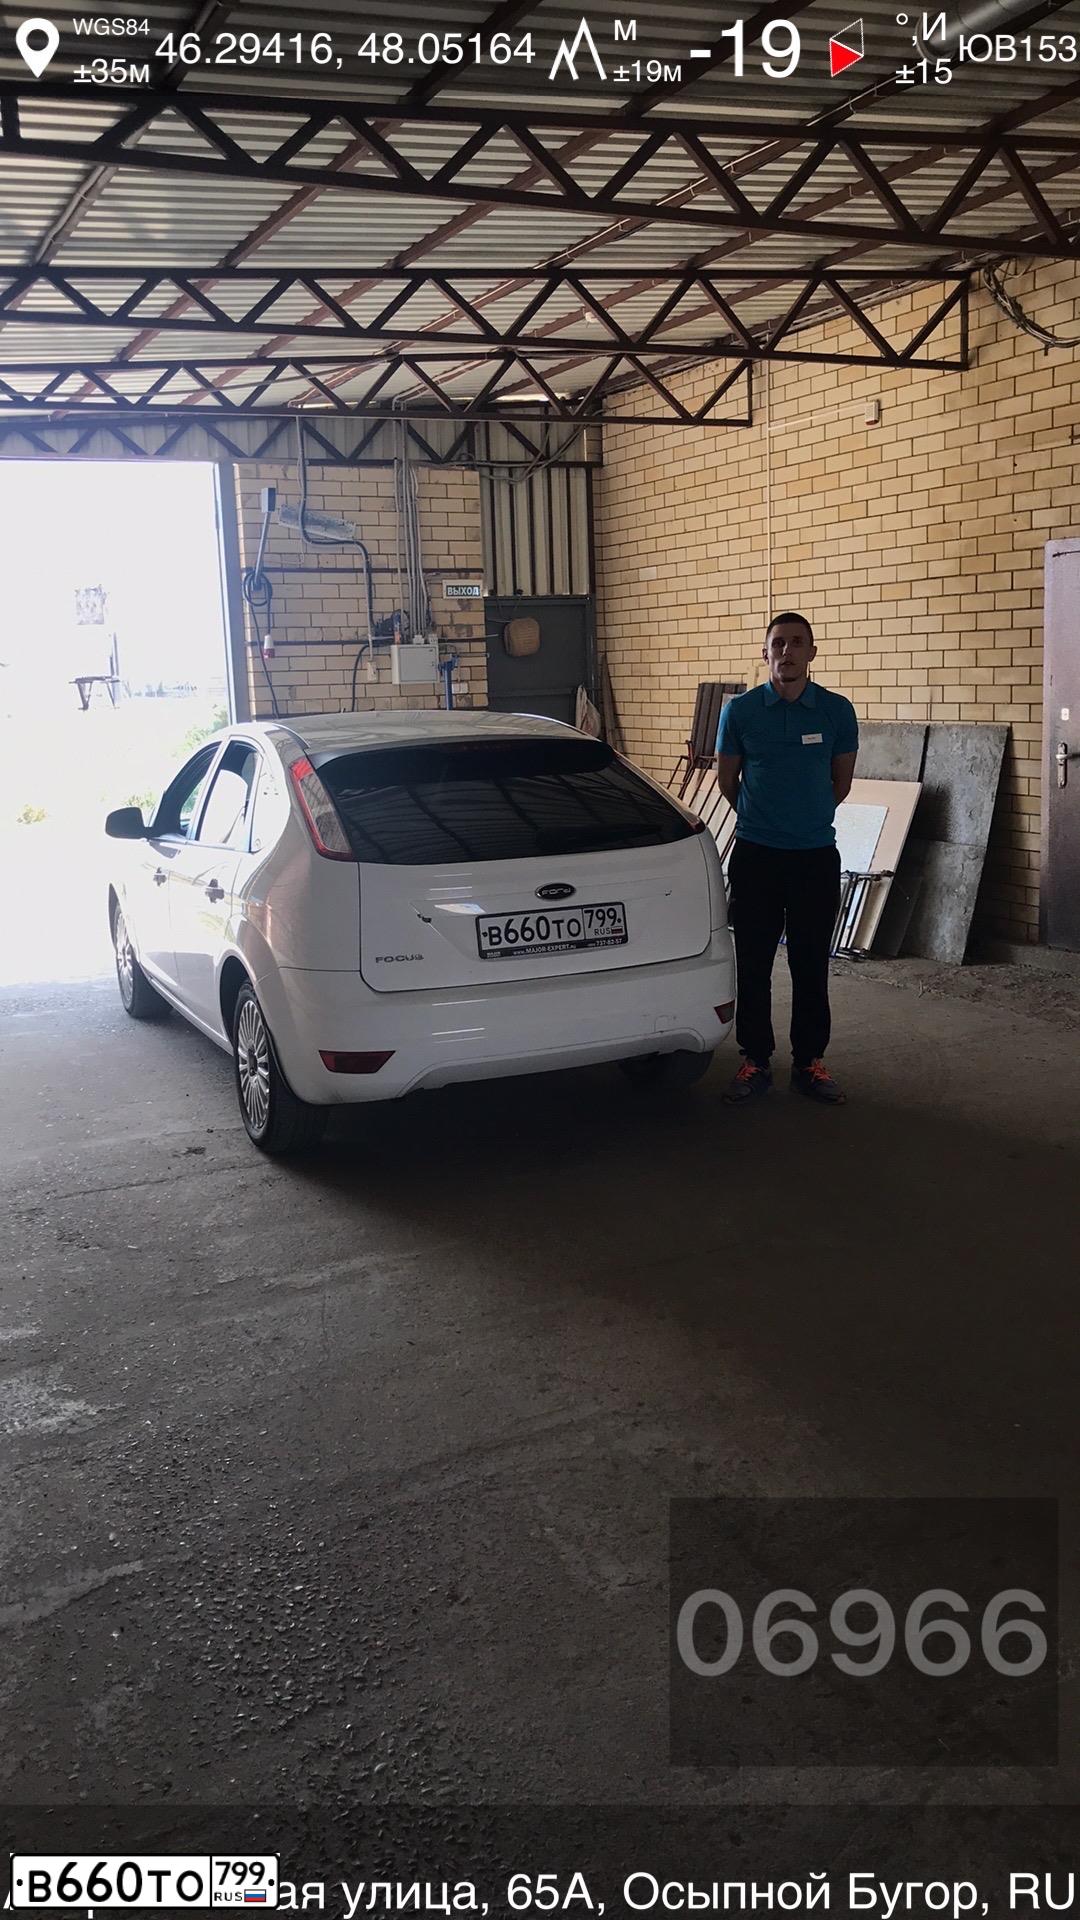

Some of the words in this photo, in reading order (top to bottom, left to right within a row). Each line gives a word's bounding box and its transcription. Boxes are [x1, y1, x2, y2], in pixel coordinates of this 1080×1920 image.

[447, 586, 480, 596] ВЫХОД
[584, 907, 617, 928] 799
[593, 926, 611, 936] RUS
[375, 953, 425, 964] FOCUS
